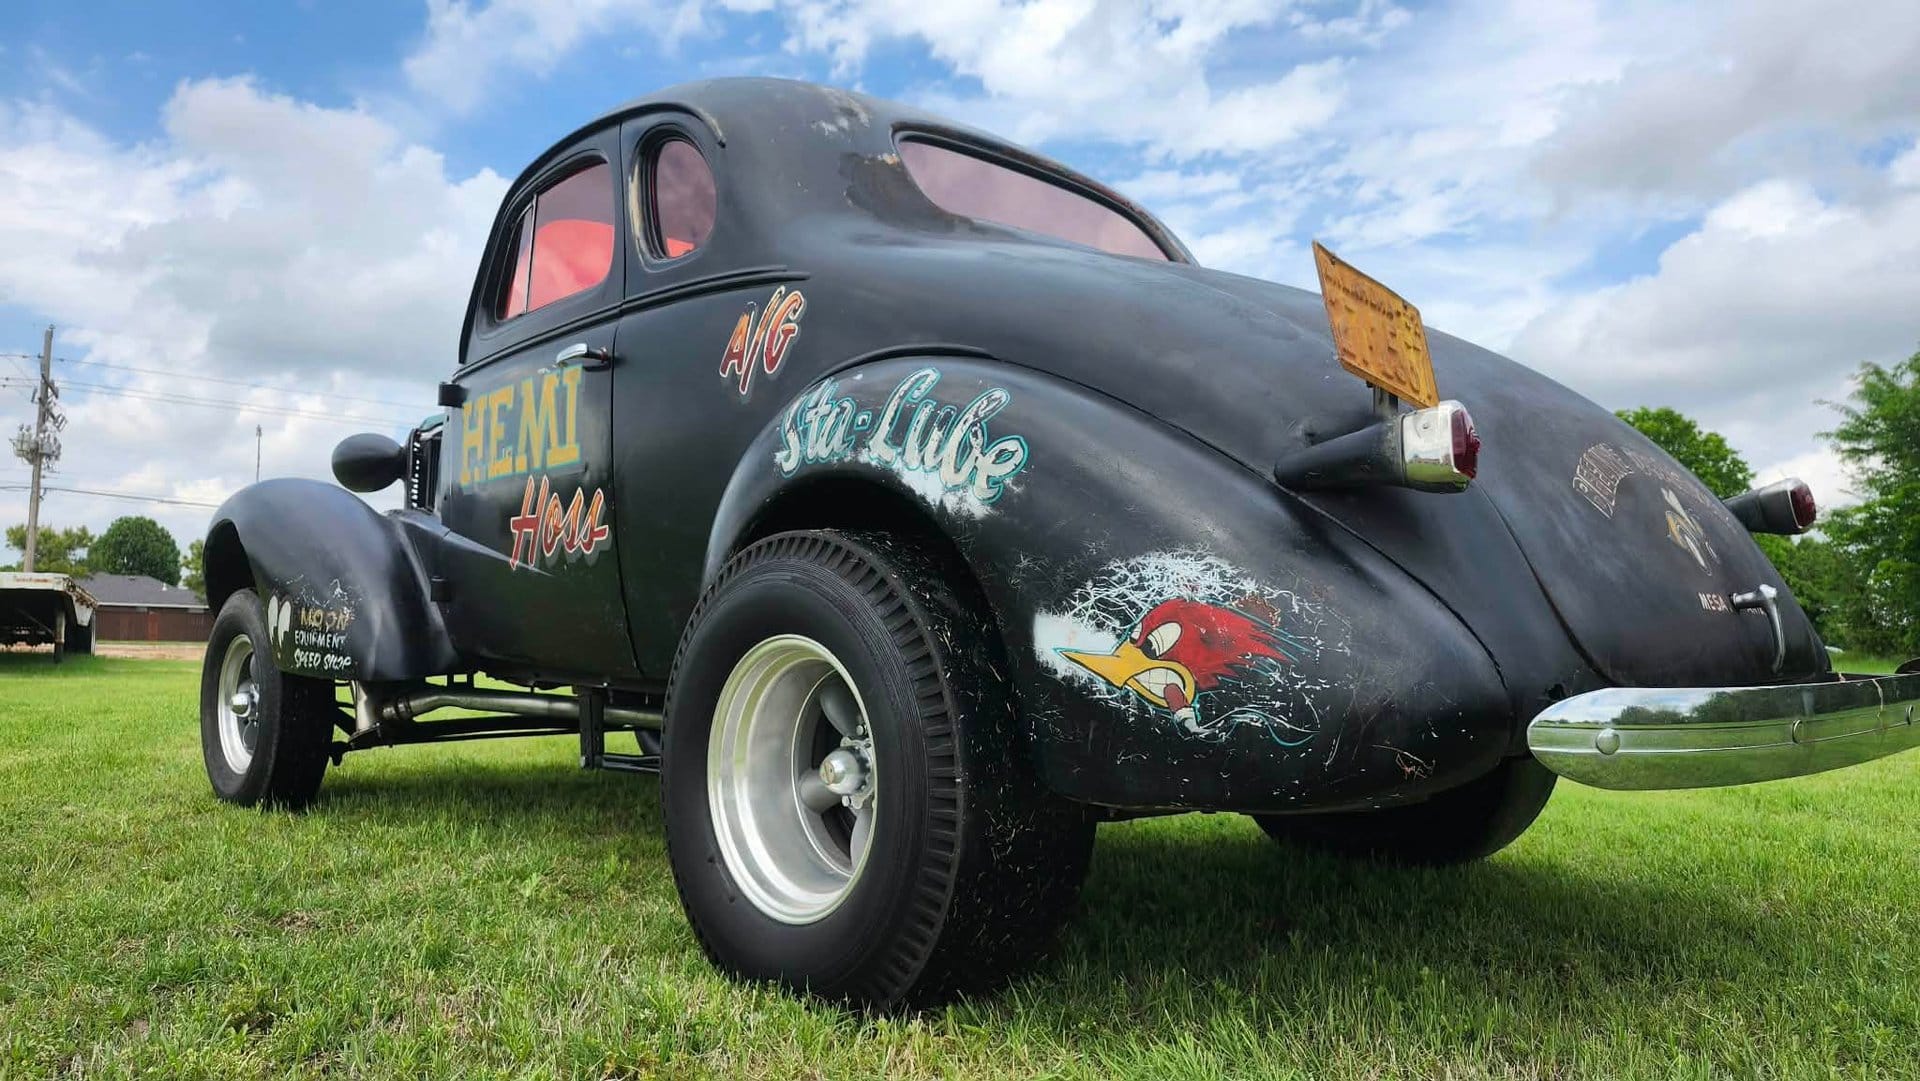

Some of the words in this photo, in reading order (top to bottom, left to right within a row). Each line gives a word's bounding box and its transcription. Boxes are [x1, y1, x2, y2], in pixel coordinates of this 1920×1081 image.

[719, 285, 805, 395] A/G
[460, 364, 583, 487] HEMI
[509, 474, 609, 569] Hoss
[294, 629, 346, 649] EQUIPMENT
[300, 607, 352, 632] MOON
[294, 648, 321, 669] SPEED
[323, 653, 352, 670] SHOP
